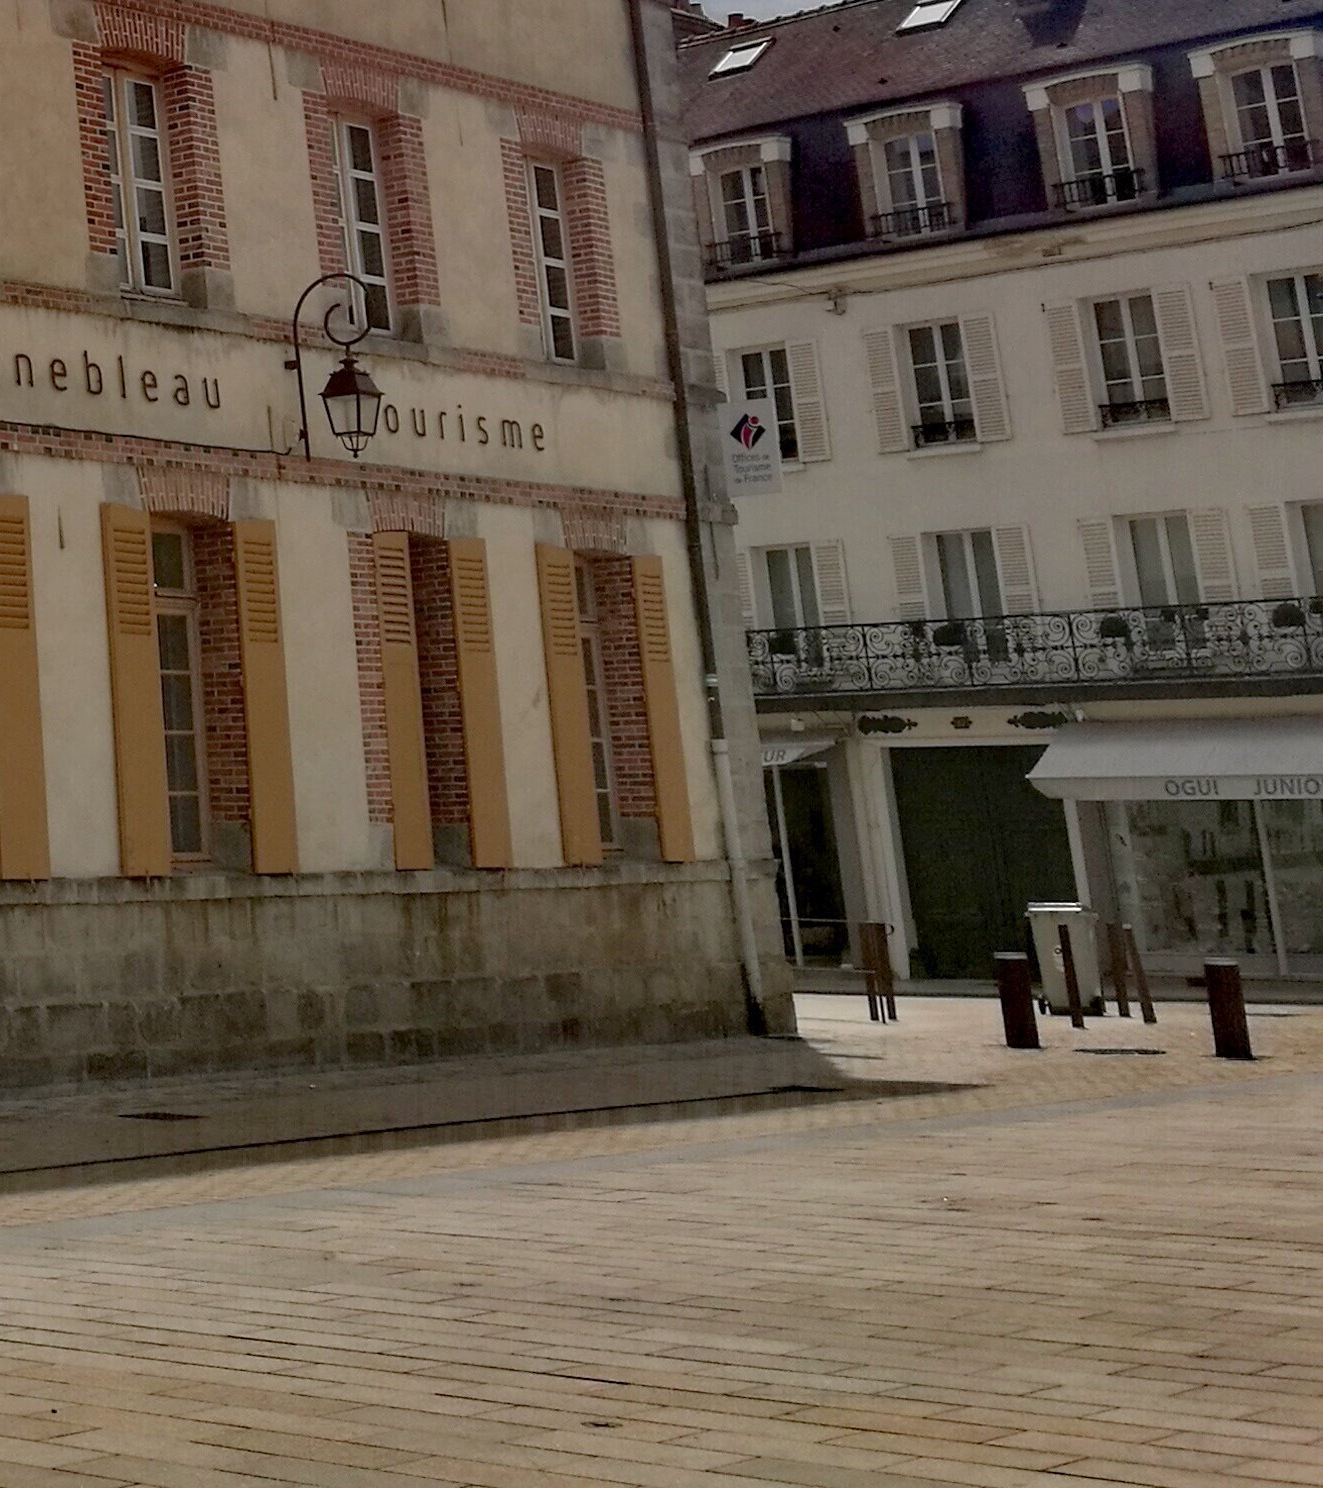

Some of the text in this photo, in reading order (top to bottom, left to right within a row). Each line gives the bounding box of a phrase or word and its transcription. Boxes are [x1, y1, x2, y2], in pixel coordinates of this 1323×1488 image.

[383, 403, 546, 452] ourisme
[763, 748, 786, 763] UR
[1164, 778, 1321, 796] OGUI JUNIO
